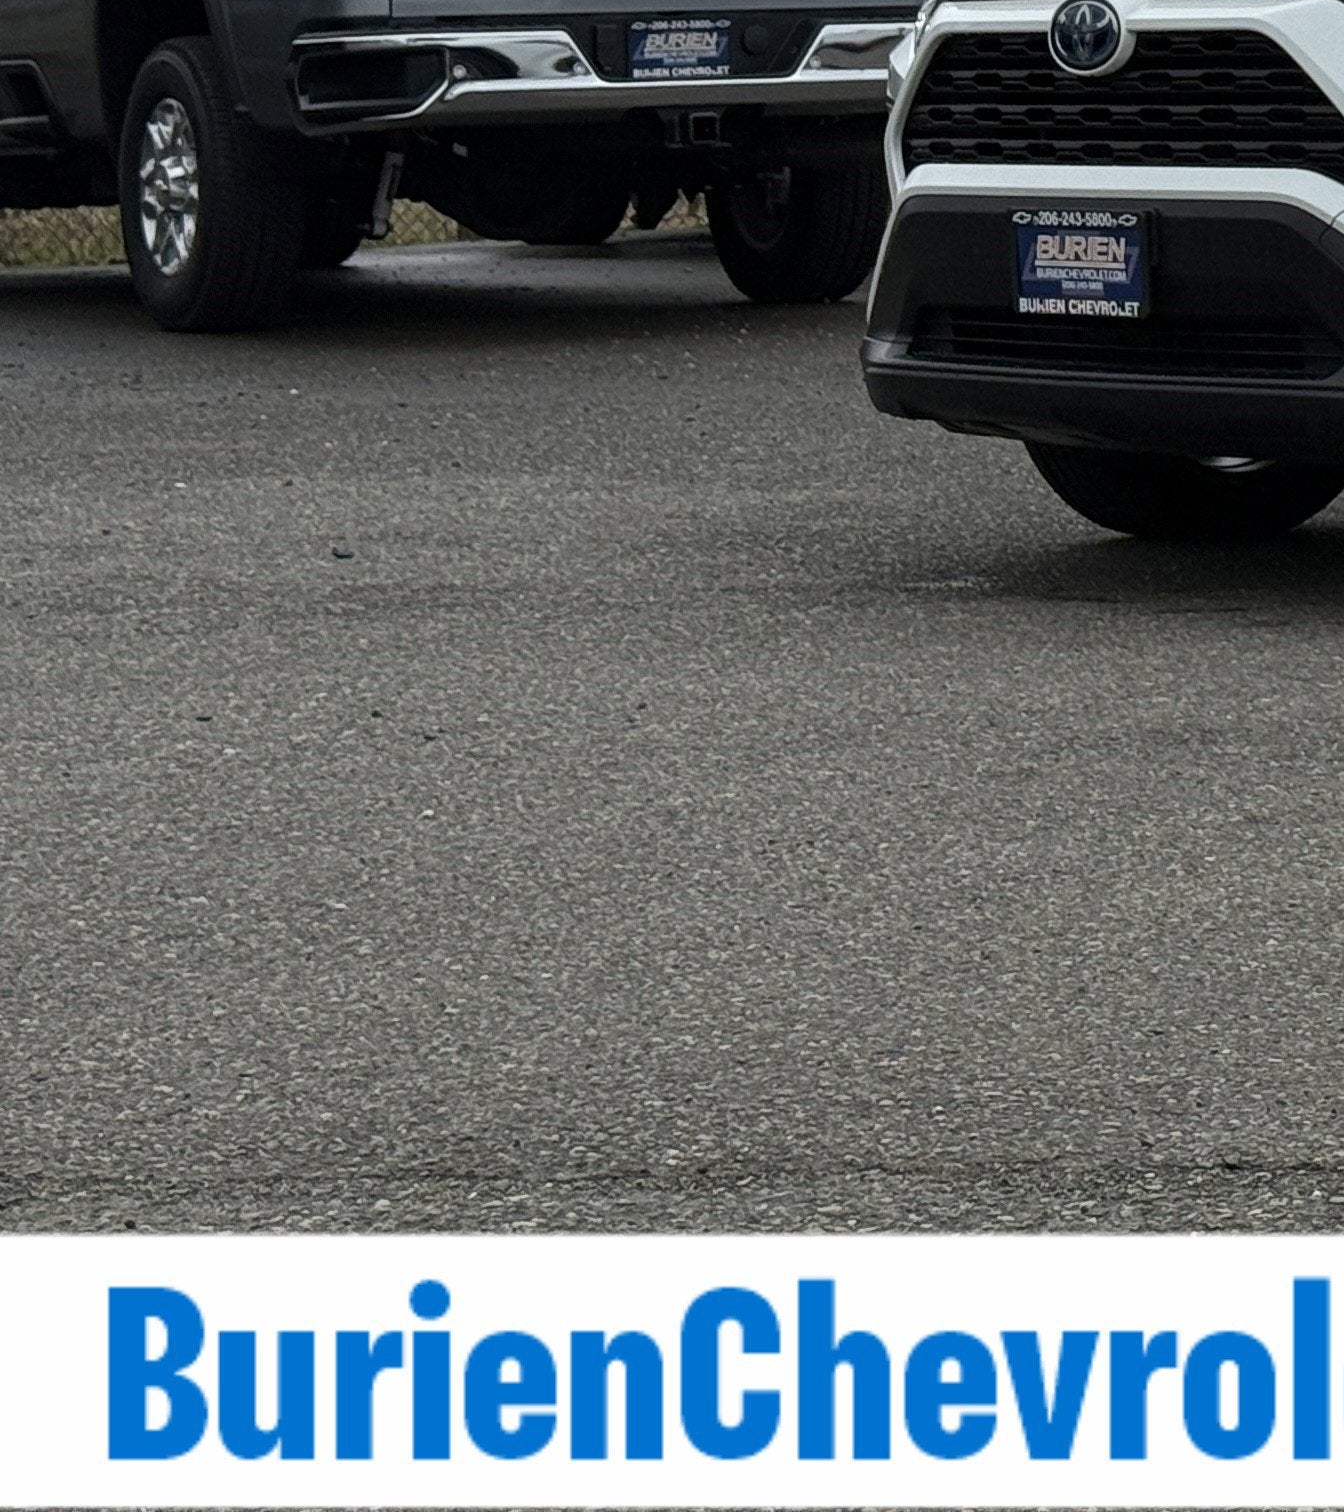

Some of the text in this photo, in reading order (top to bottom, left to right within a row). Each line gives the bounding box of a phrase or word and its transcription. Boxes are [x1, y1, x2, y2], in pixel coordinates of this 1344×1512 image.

[646, 32, 718, 49] BURIEN
[1037, 210, 1113, 227] 206-243-5800
[1036, 234, 1126, 261] BURIEN
